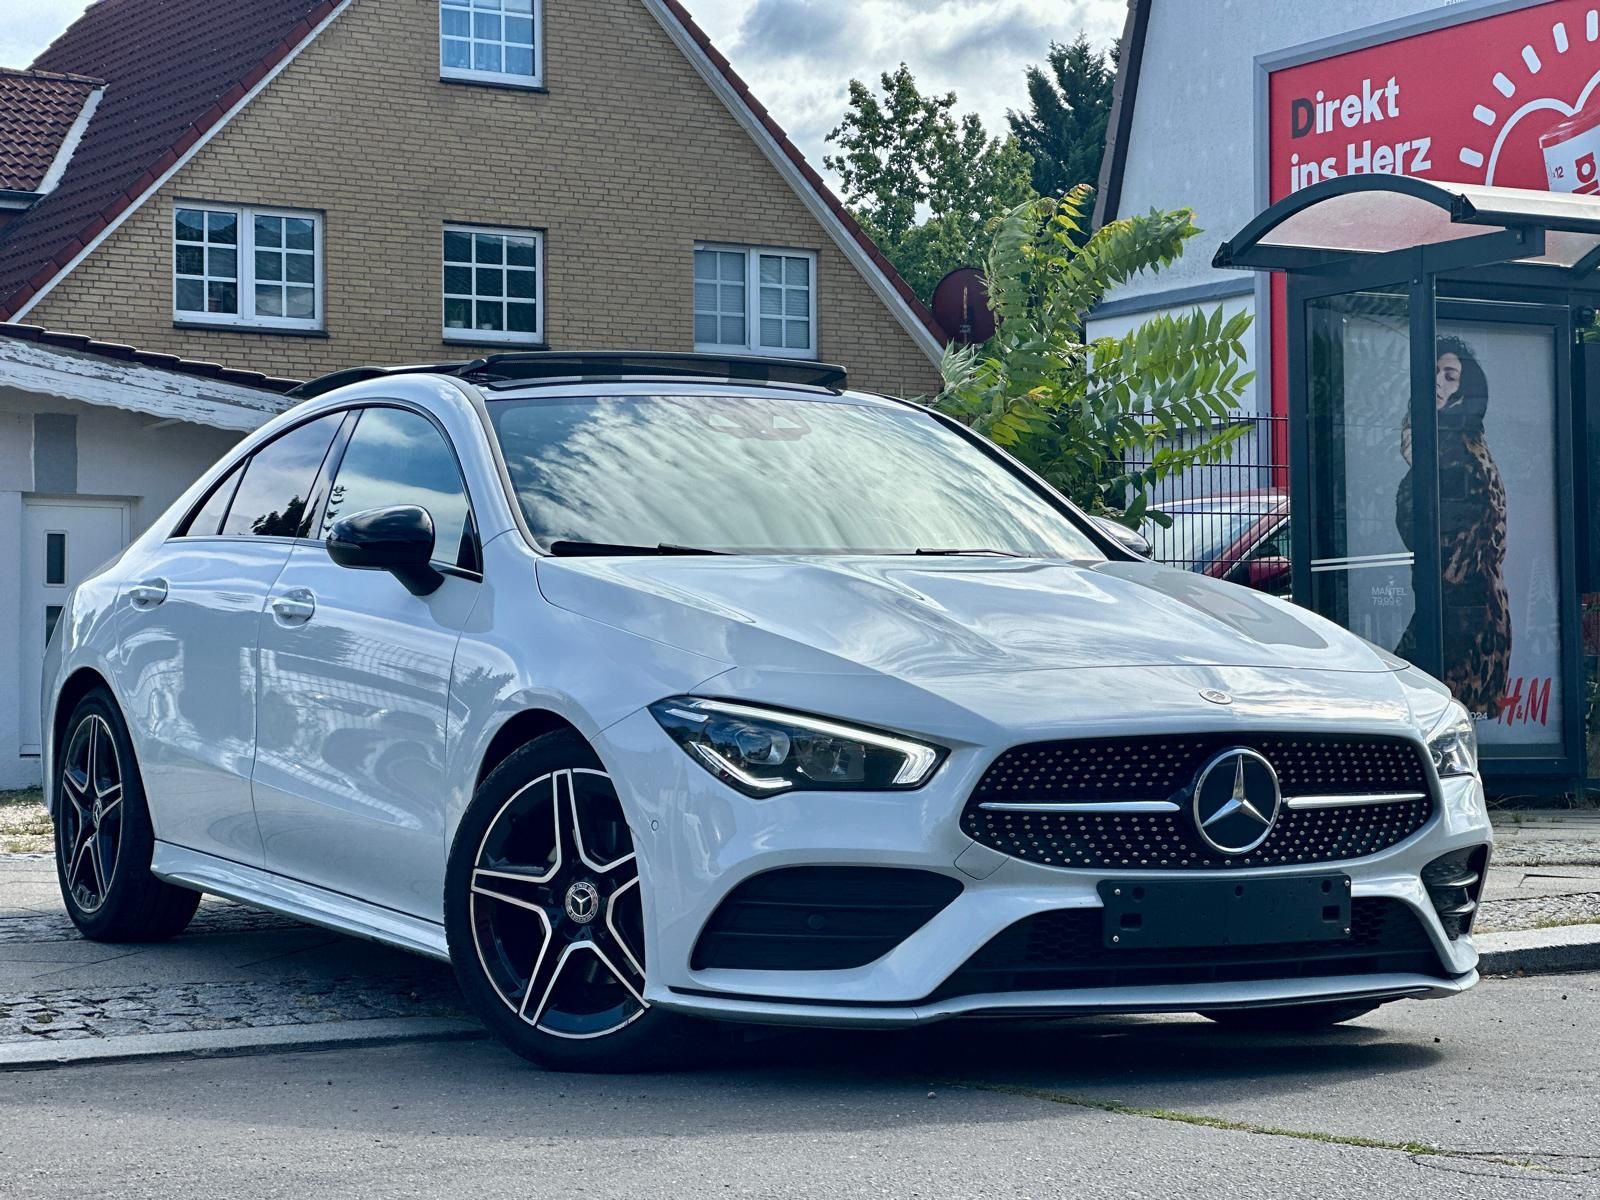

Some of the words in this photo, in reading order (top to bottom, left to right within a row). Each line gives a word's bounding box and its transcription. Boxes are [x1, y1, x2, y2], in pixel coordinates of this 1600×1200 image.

[1291, 76, 1400, 139] Direkt
[1291, 153, 1339, 194] ins
[1347, 137, 1432, 178] Herz
[1371, 586, 1408, 596] MANTEL
[1470, 711, 1489, 721] 024
[1496, 677, 1552, 726] H&M
